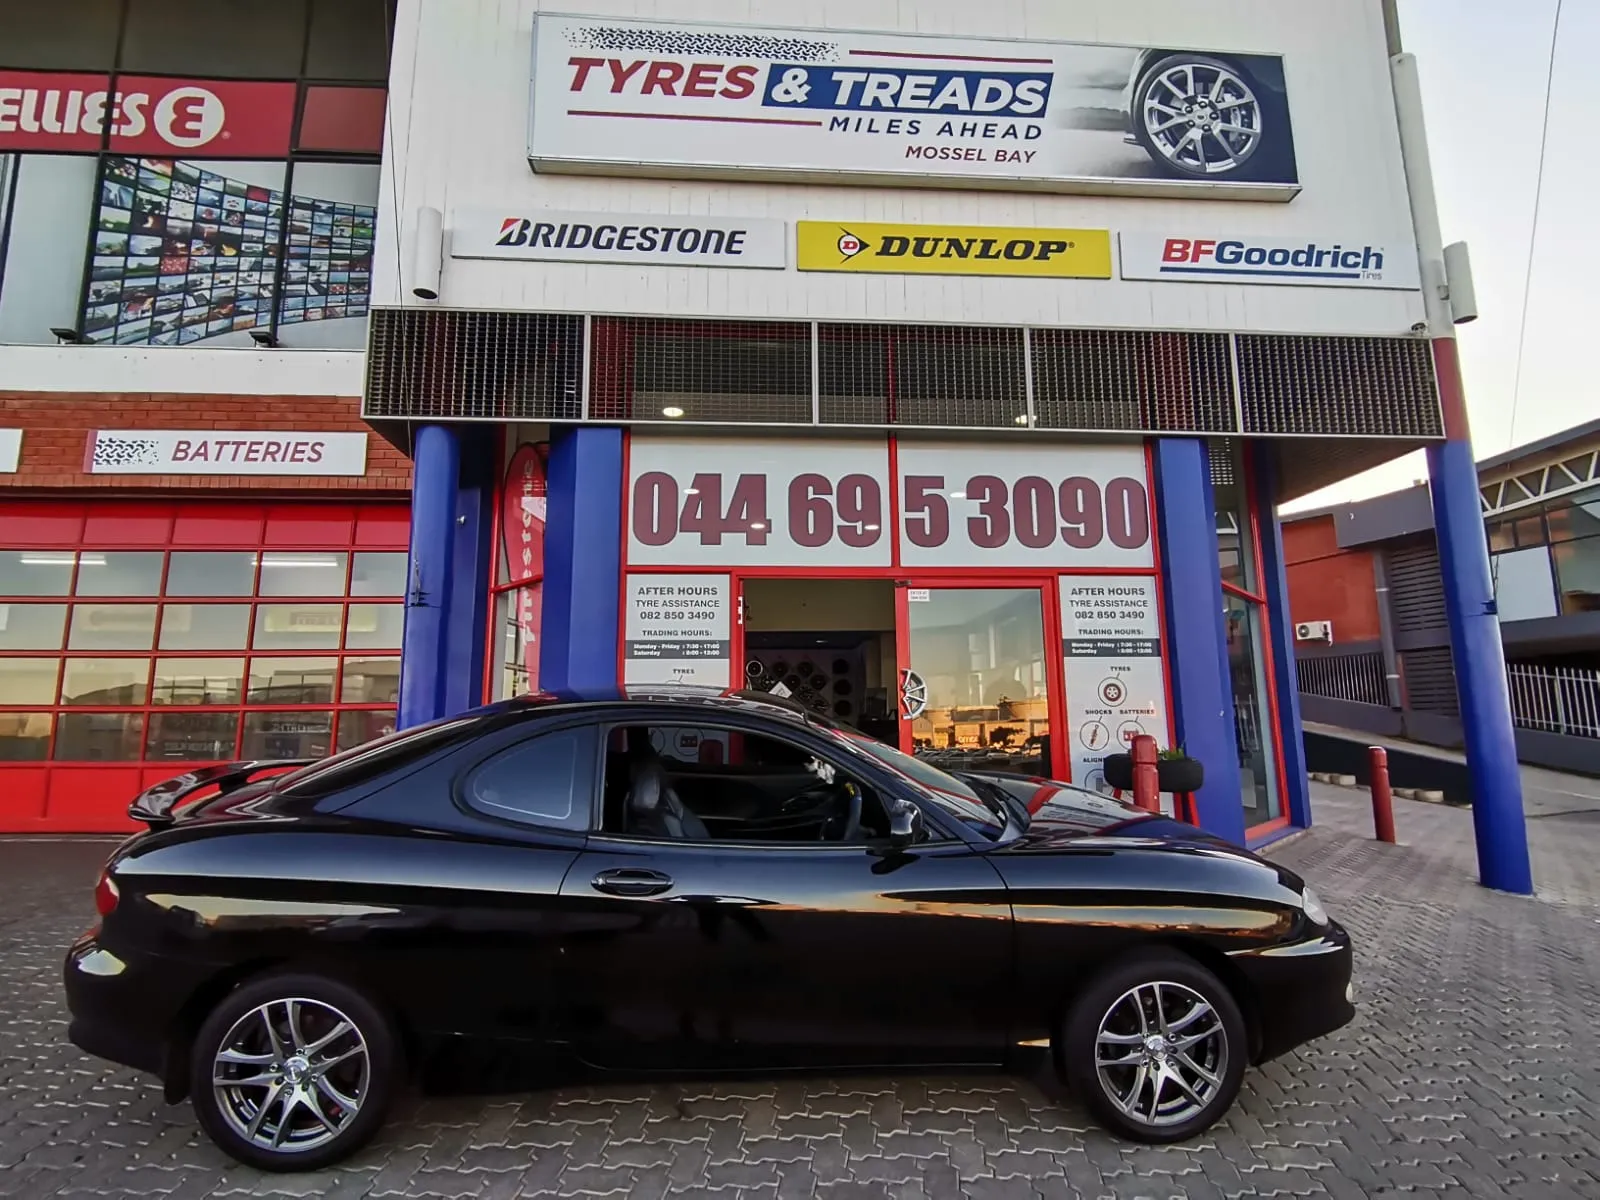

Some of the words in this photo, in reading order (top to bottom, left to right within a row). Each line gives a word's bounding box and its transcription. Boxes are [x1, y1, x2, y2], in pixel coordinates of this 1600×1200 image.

[568, 57, 760, 100] TYRES
[770, 67, 812, 104] &
[831, 71, 1049, 114] TREADS
[829, 116, 920, 136] MILES
[936, 121, 1043, 141] AHEAD
[905, 145, 987, 162] MOSSEL
[994, 149, 1037, 164] BAY
[496, 218, 747, 255] BRIDGESTONE
[875, 236, 1067, 261] DUNLOP
[1162, 238, 1383, 270] BFGoodrich
[1361, 270, 1383, 280] Tires
[171, 440, 325, 463] BATTERIES
[632, 471, 772, 546] 044
[966, 475, 1150, 549] 3090
[638, 587, 674, 596] AFTER
[677, 587, 718, 596] HOURS
[1071, 587, 1105, 596] AFTER
[1108, 587, 1145, 596] HOURS
[636, 599, 660, 608] TYRE
[662, 599, 720, 608] ASSISTANCE
[1070, 599, 1092, 608] TYRE
[1094, 599, 1149, 608] ASSISTANCE
[640, 611, 661, 620] 082
[664, 611, 685, 620] 850
[688, 611, 715, 620] 3490
[1075, 611, 1094, 619] 082
[1097, 611, 1116, 619] 850
[1119, 611, 1145, 619] 3490
